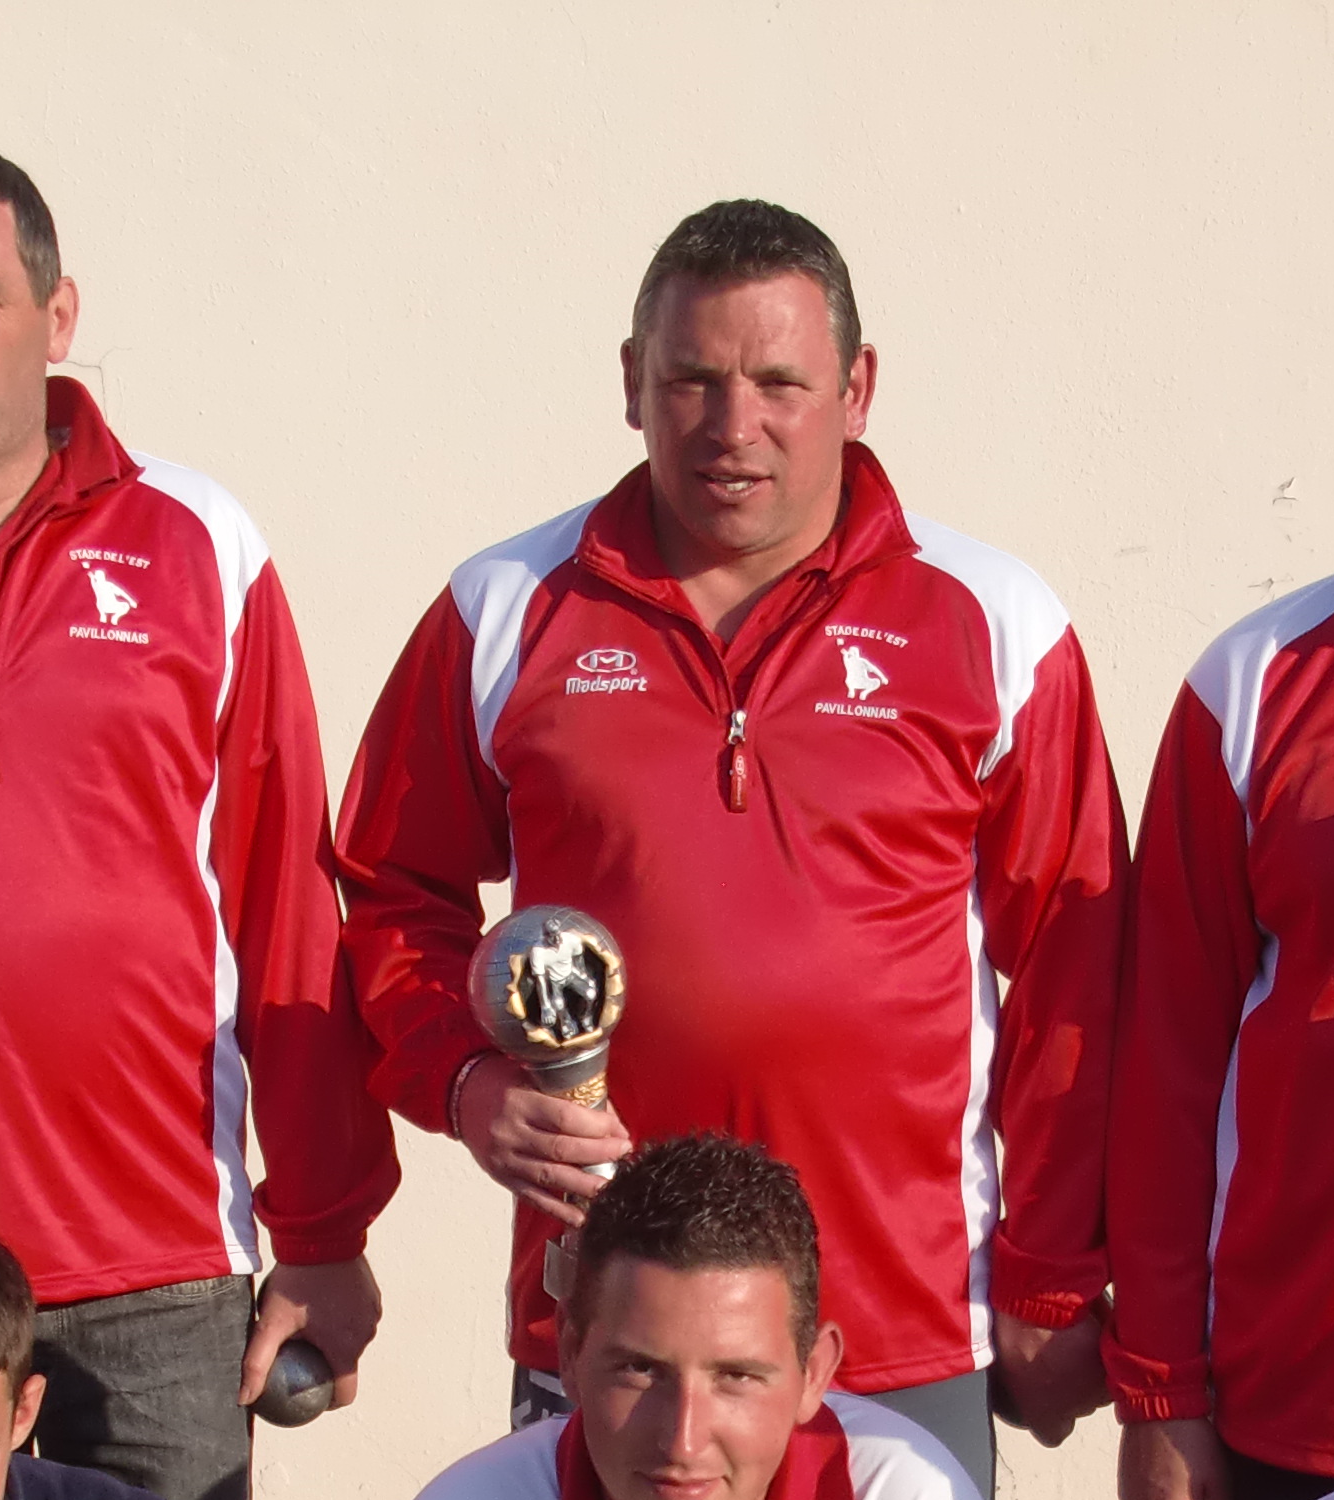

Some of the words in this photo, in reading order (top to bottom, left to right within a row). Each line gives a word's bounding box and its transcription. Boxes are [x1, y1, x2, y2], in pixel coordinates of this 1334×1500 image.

[69, 549, 102, 561] STADE
[103, 551, 118, 563] DE
[69, 626, 150, 645] PAVILLONNAIS
[824, 625, 860, 637] STADE
[860, 628, 876, 639] DE
[565, 675, 648, 696] Madsport
[814, 702, 898, 720] PAVILLONNAIS
